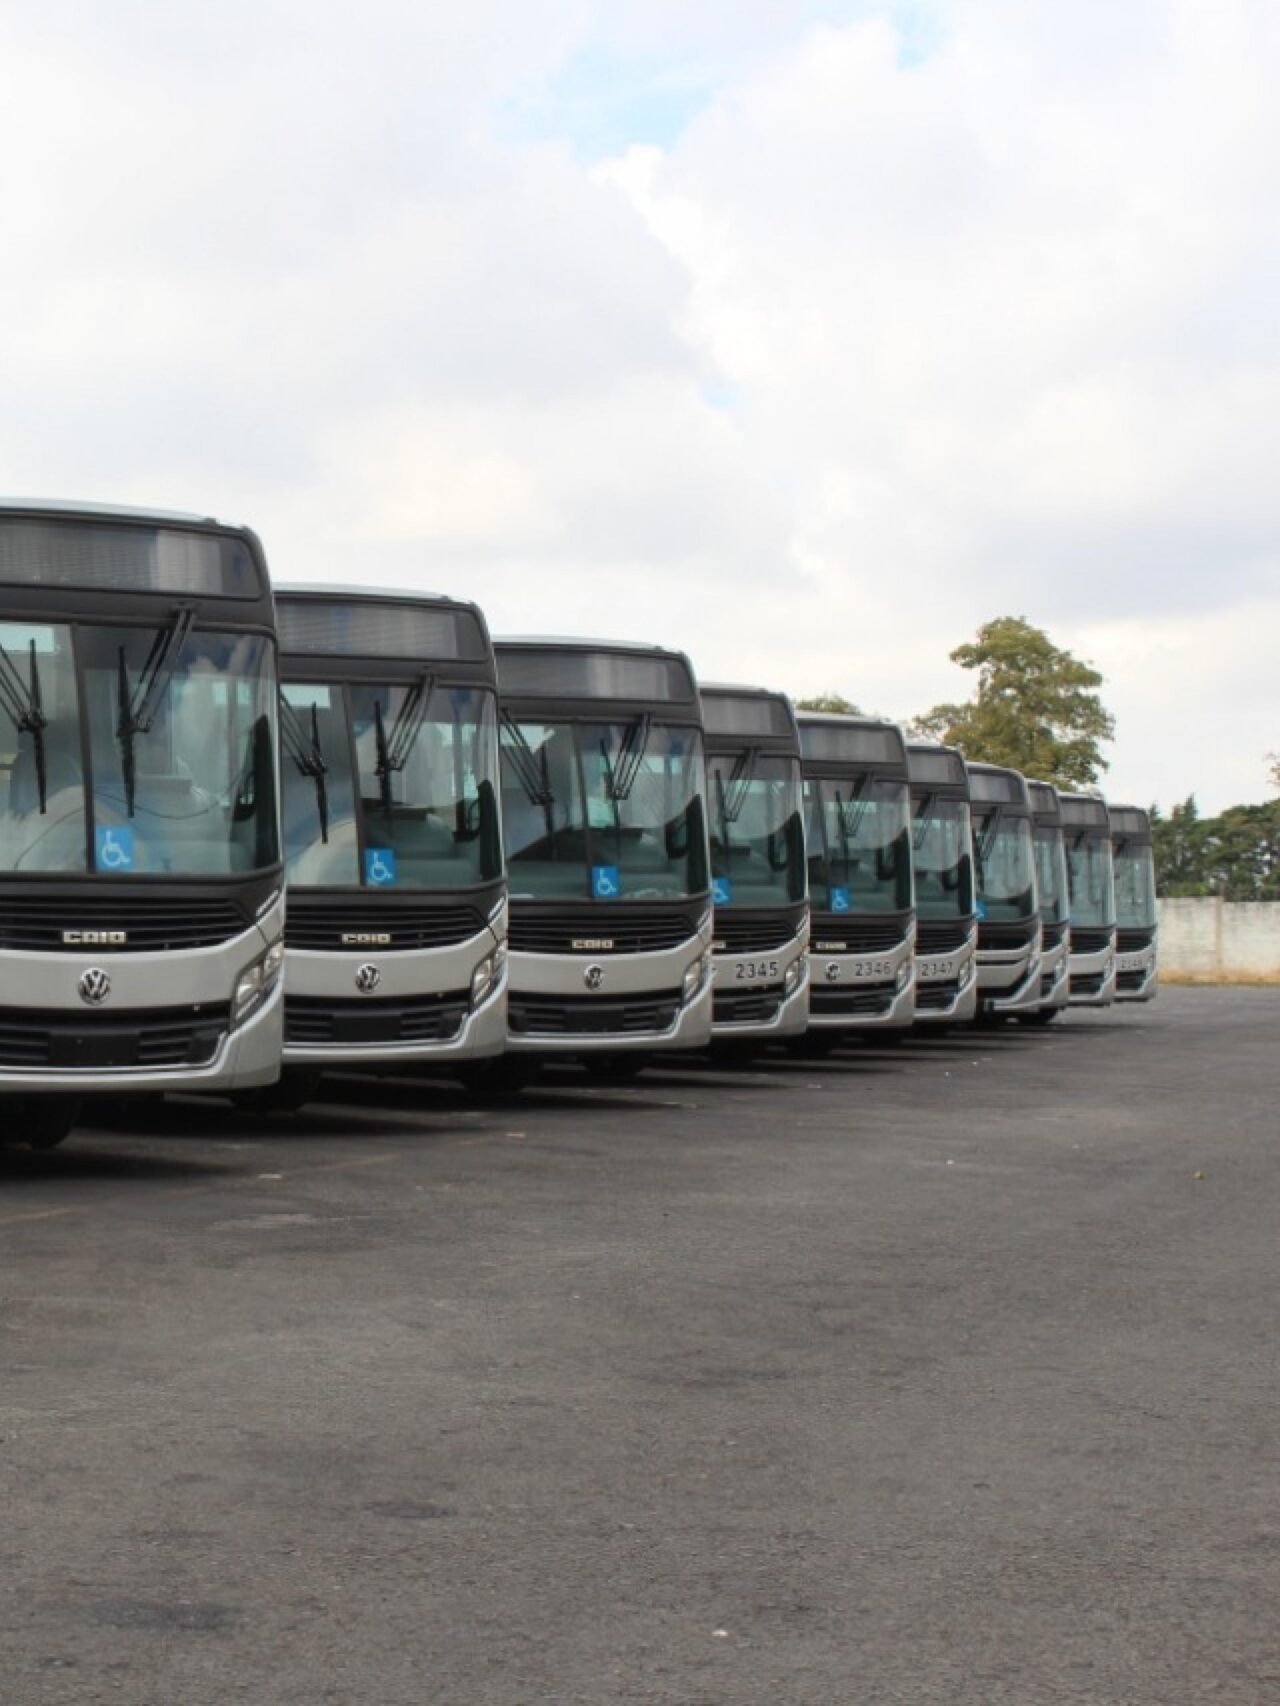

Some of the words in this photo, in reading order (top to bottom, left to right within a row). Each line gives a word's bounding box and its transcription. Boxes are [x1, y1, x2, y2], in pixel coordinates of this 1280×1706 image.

[63, 931, 127, 944] CAIO
[735, 962, 778, 979] 2345
[855, 962, 891, 977] 2346
[921, 961, 953, 977] 2347
